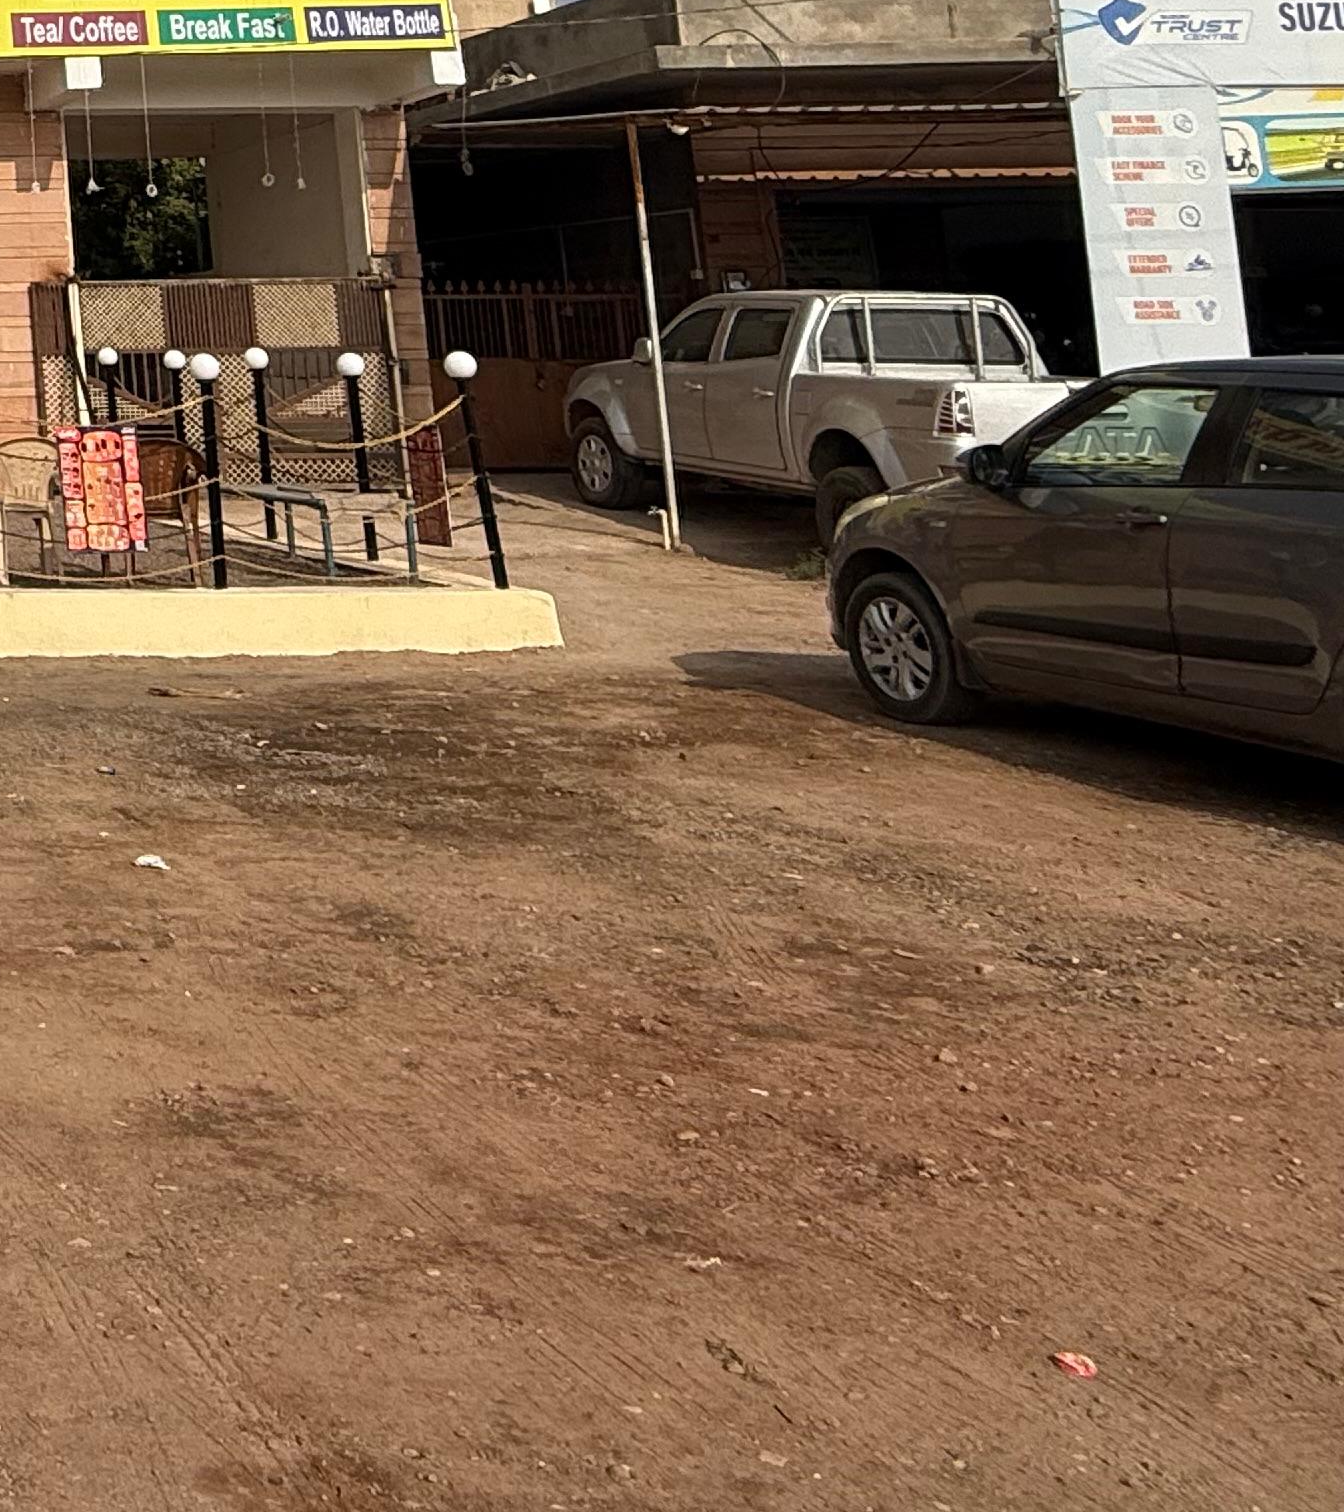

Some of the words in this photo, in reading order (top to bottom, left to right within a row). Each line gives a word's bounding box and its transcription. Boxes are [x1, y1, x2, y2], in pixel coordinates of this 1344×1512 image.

[69, 15, 139, 42] Coffee
[169, 13, 233, 41] Break
[309, 11, 344, 38] R.O.
[345, 10, 390, 37] Water
[392, 8, 440, 37] Bottle
[1150, 19, 1244, 33] TRUST
[1183, 33, 1240, 41] CENTRE
